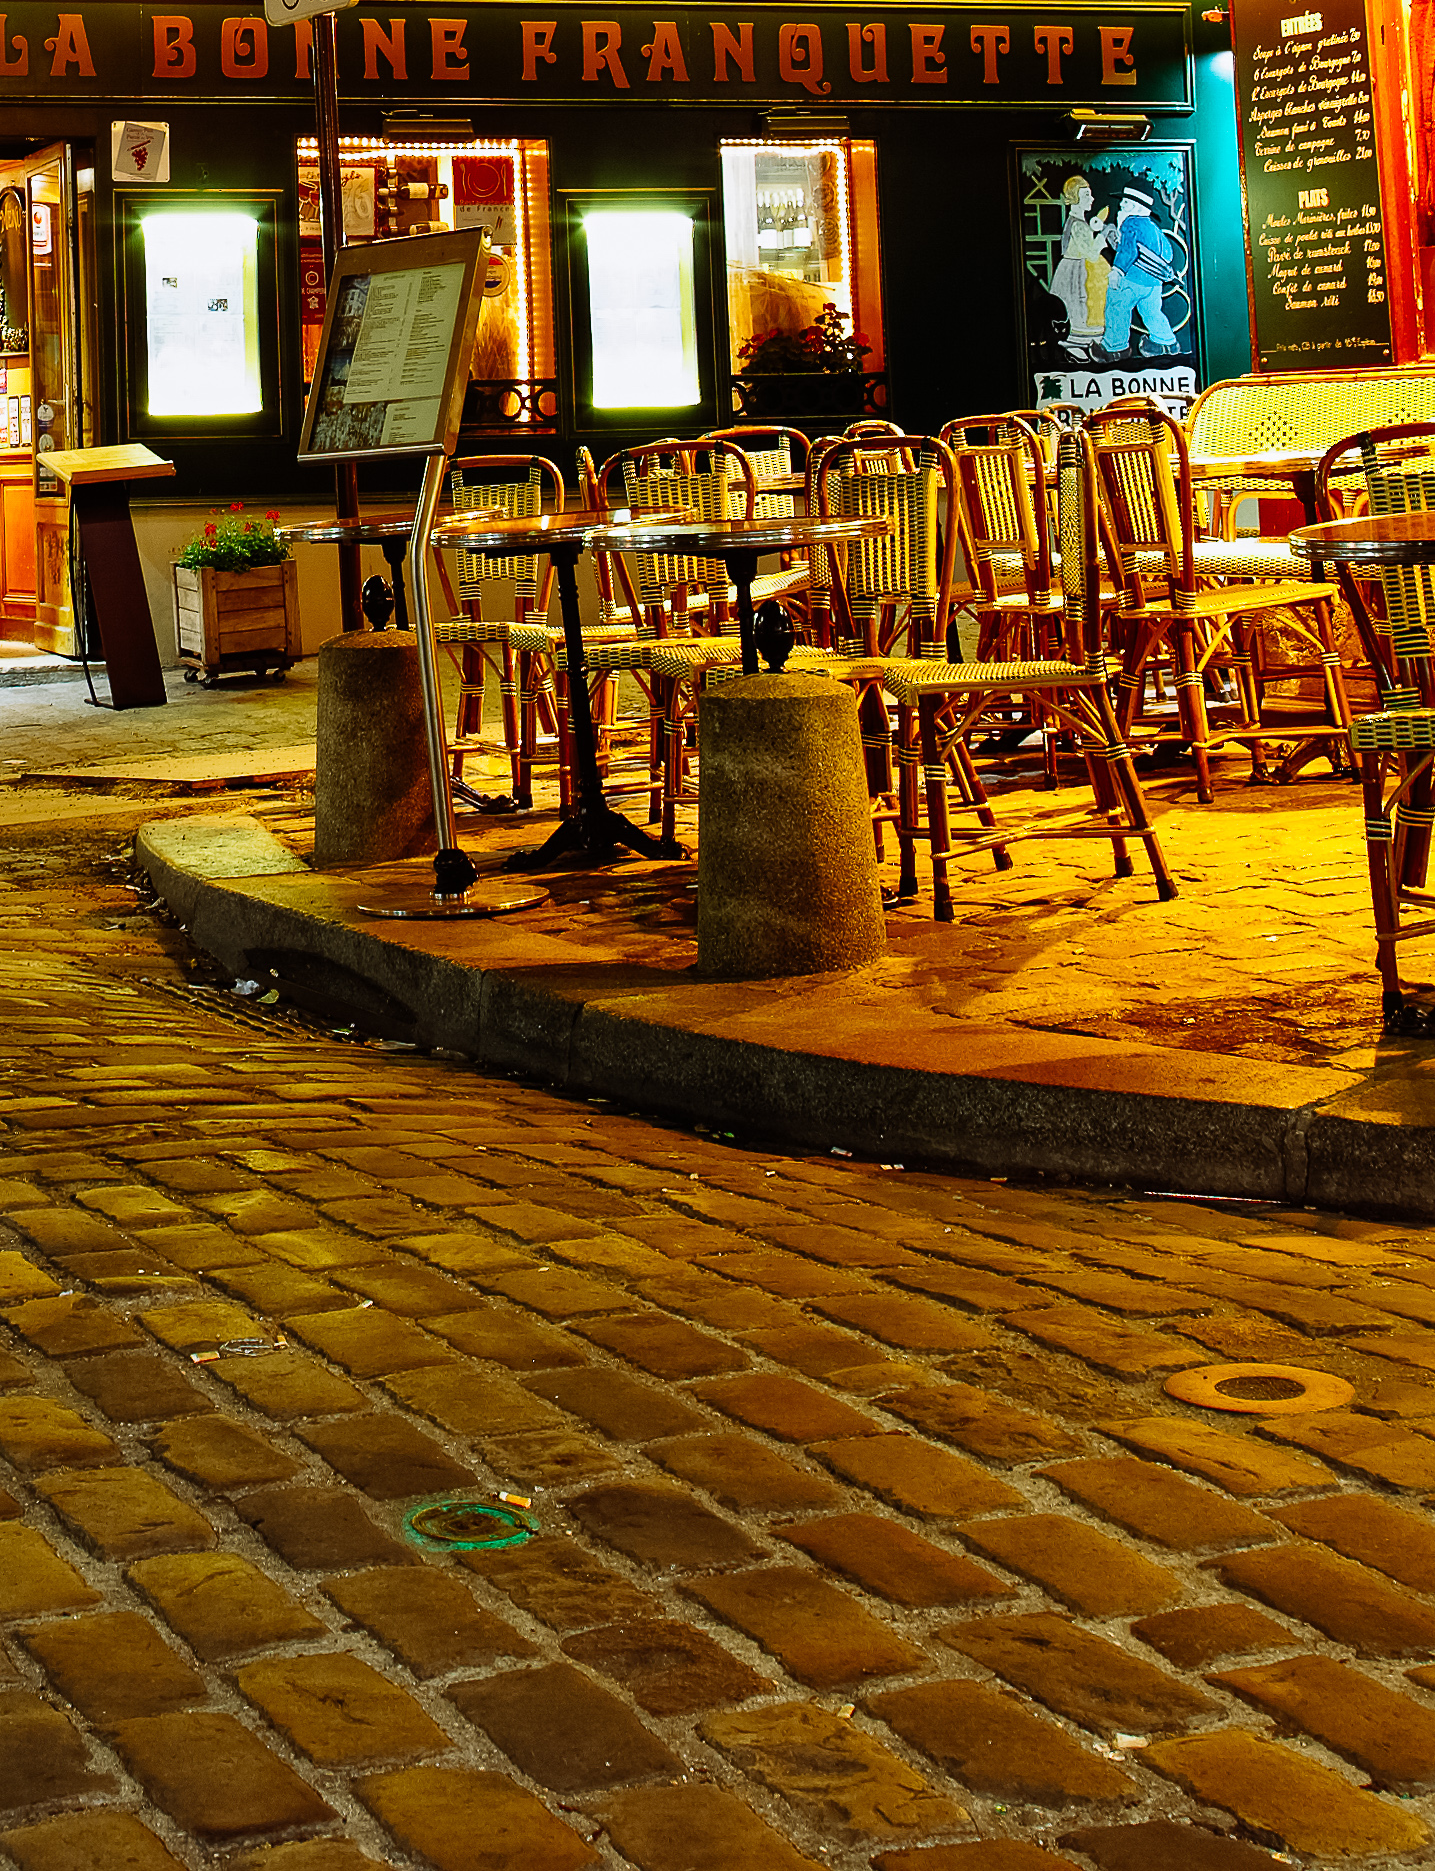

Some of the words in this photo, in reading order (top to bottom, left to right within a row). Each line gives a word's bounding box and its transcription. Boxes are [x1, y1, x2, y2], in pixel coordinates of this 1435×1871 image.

[1280, 10, 1323, 37] ENTRÉES
[521, 19, 1138, 96] FRANQUETTE
[1292, 157, 1304, 168] de
[1298, 188, 1330, 209] PLATS
[1300, 264, 1311, 275] de
[1070, 378, 1102, 399] LA
[1111, 377, 1190, 396] BONNE
